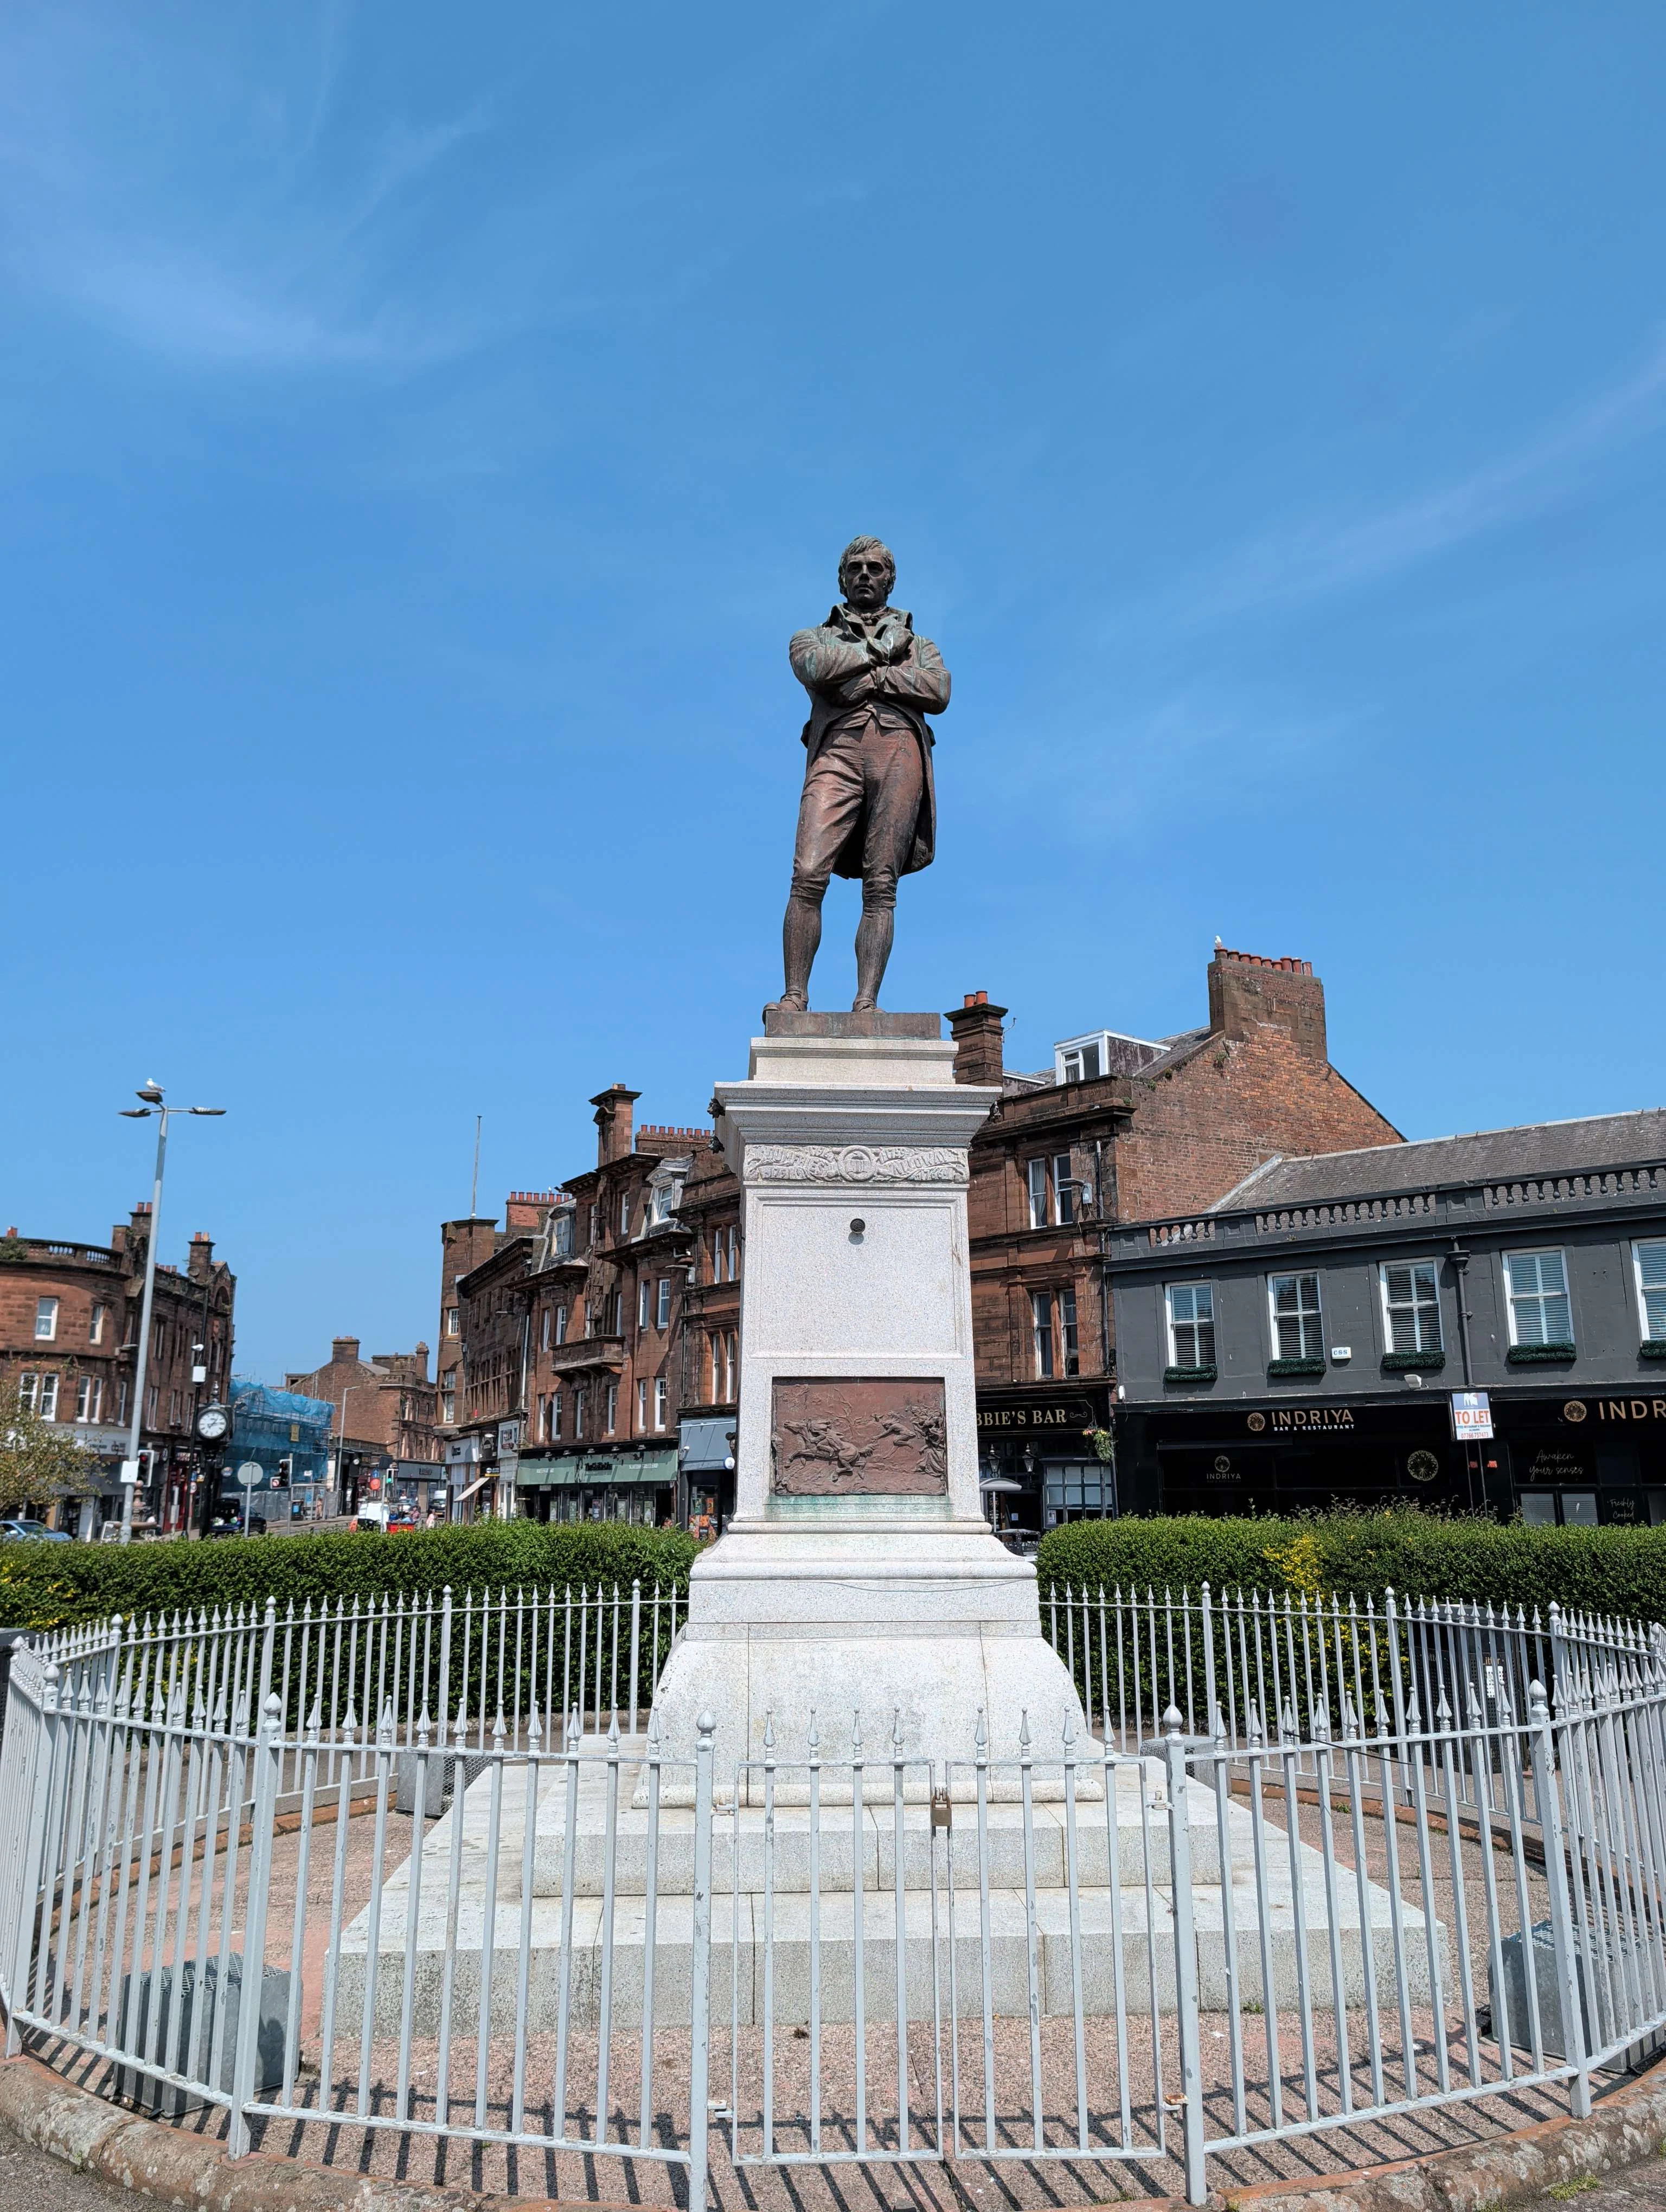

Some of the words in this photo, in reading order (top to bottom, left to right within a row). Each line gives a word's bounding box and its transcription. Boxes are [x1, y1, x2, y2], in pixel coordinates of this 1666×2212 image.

[1032, 1409, 1067, 1424] BAR
[1271, 1409, 1354, 1425] INDRIYA
[1455, 1411, 1470, 1424] TO
[1473, 1410, 1489, 1423] LET
[1599, 1400, 1666, 1420] INDR
[1535, 1449, 1574, 1463] Awaken
[1529, 1465, 1553, 1482] your
[1555, 1466, 1584, 1475] senses
[1609, 1497, 1635, 1510] Freshly
[1613, 1509, 1635, 1520] Cooked
